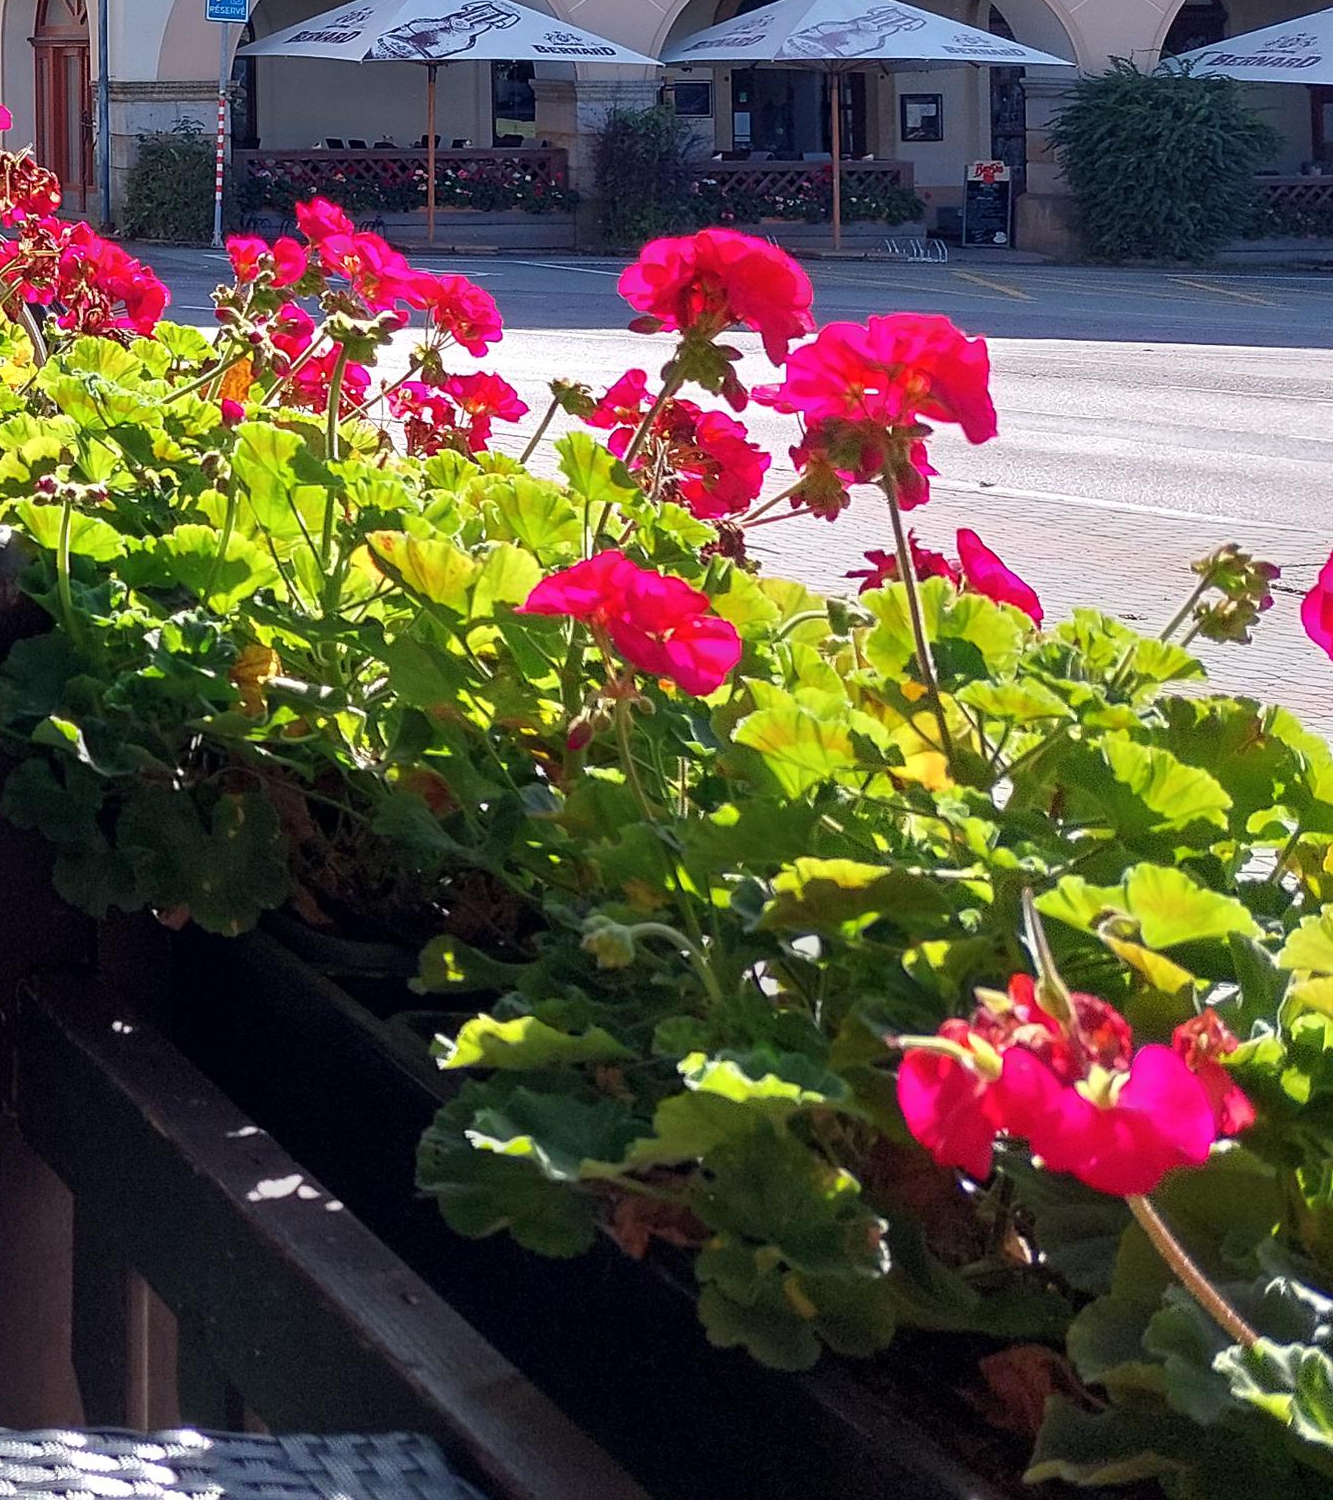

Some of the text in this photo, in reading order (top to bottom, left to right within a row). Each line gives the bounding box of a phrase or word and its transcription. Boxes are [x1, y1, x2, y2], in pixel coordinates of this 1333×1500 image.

[209, 4, 246, 16] RÉSERVÉ
[531, 44, 617, 56] BERNARD
[1206, 53, 1323, 69] BERNARD
